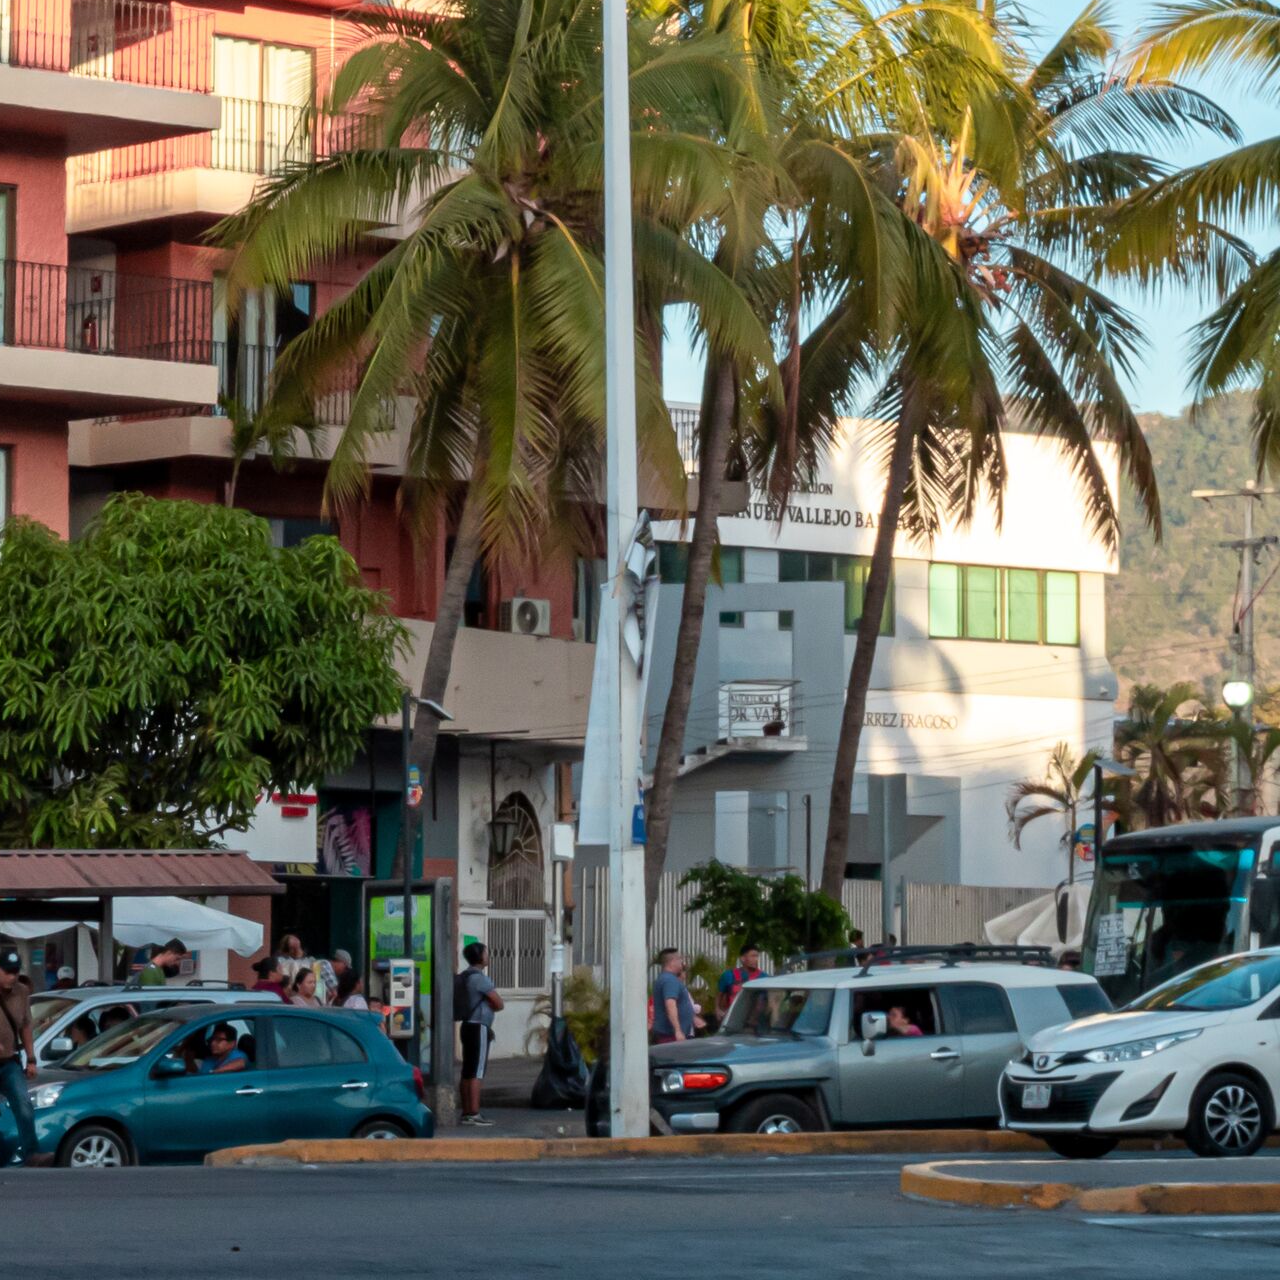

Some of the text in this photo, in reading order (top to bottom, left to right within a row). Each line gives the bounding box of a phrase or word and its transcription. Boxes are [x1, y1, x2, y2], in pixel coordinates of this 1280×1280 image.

[786, 505, 852, 527] VALLEJO
[862, 712, 958, 729] RREZ FRAGOSO
